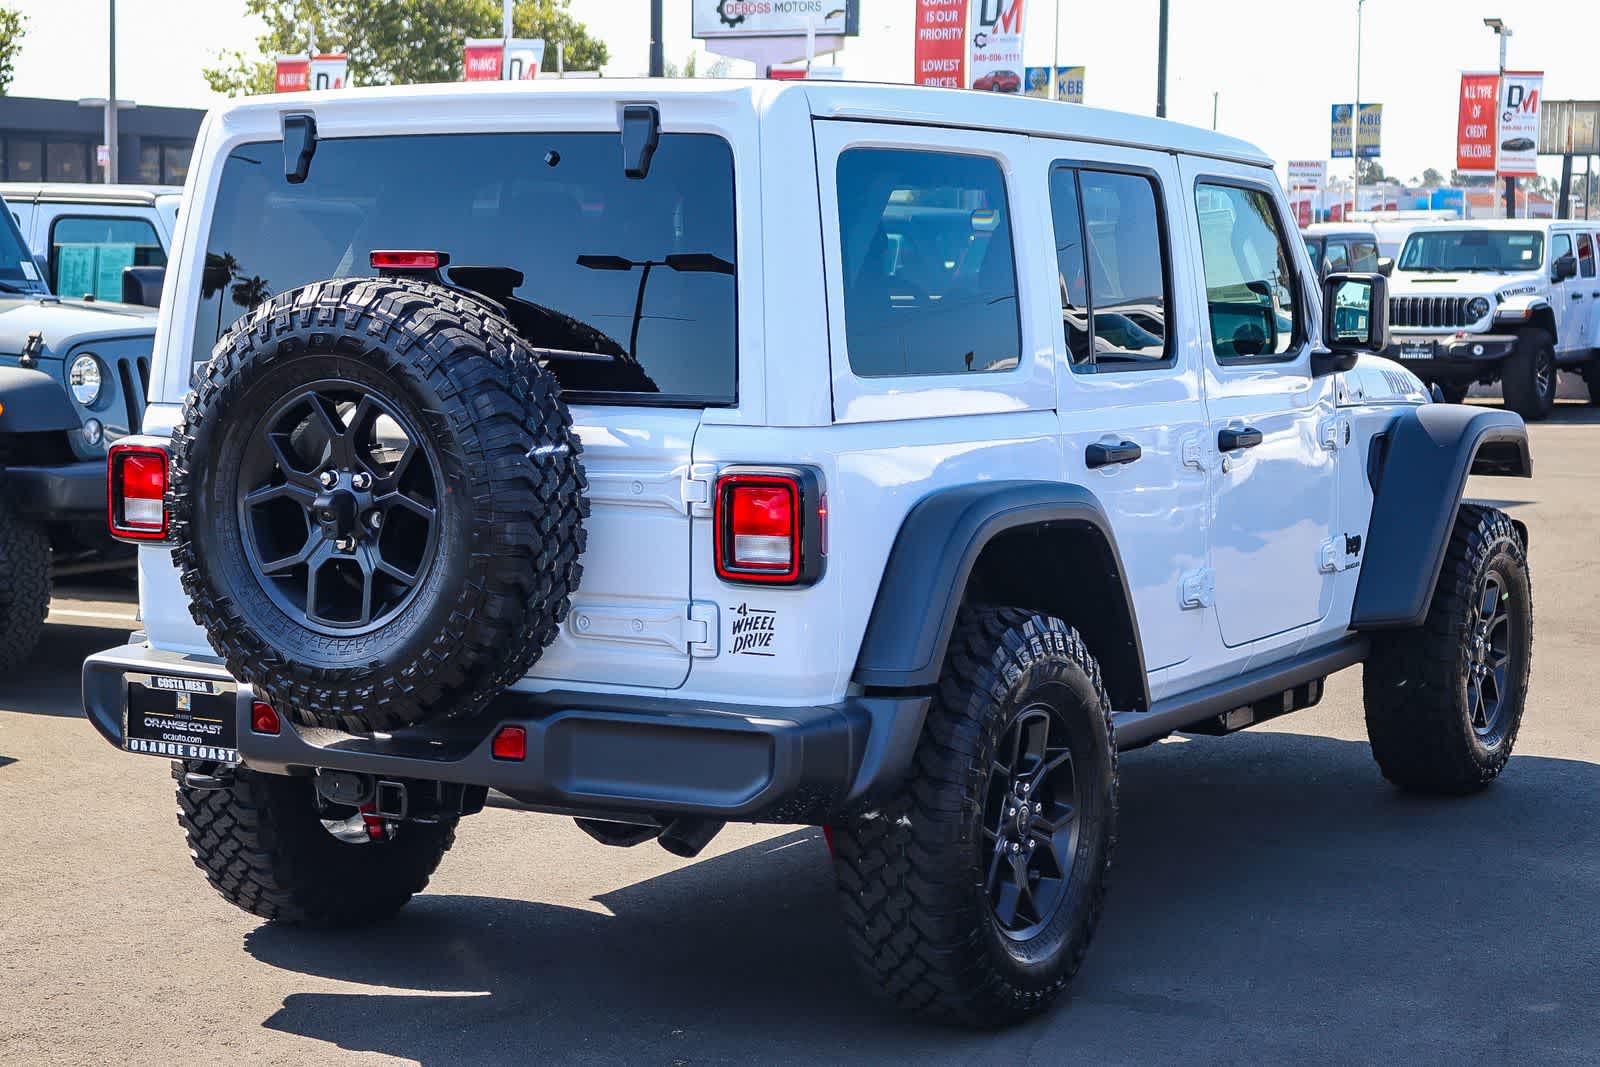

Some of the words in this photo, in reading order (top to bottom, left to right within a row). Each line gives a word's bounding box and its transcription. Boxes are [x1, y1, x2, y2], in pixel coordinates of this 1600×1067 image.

[726, 3, 771, 15] DEBOSS
[774, 1, 822, 13] MOTORS
[926, 11, 935, 23] IS
[936, 10, 959, 22] OUR
[920, 28, 963, 40] PRIORITY
[922, 59, 960, 72] LOWEST
[1059, 79, 1083, 96] KBB
[1465, 85, 1476, 98] ALL
[1477, 86, 1493, 98] TYPE
[1508, 85, 1538, 113] DM
[1473, 104, 1482, 118] OF
[1466, 124, 1488, 138] CREDIT
[1460, 144, 1492, 158] WELCOME
[737, 602, 748, 616] 4
[732, 616, 775, 635] WHEEL
[733, 632, 774, 654] DRIVE
[158, 678, 185, 690] COSTA
[185, 680, 208, 692] MESA
[144, 717, 188, 731] ORANGE
[188, 722, 223, 735] COAST
[163, 733, 202, 744] ocauto.com
[130, 739, 184, 756] ORANGE
[189, 746, 235, 762] COAST
